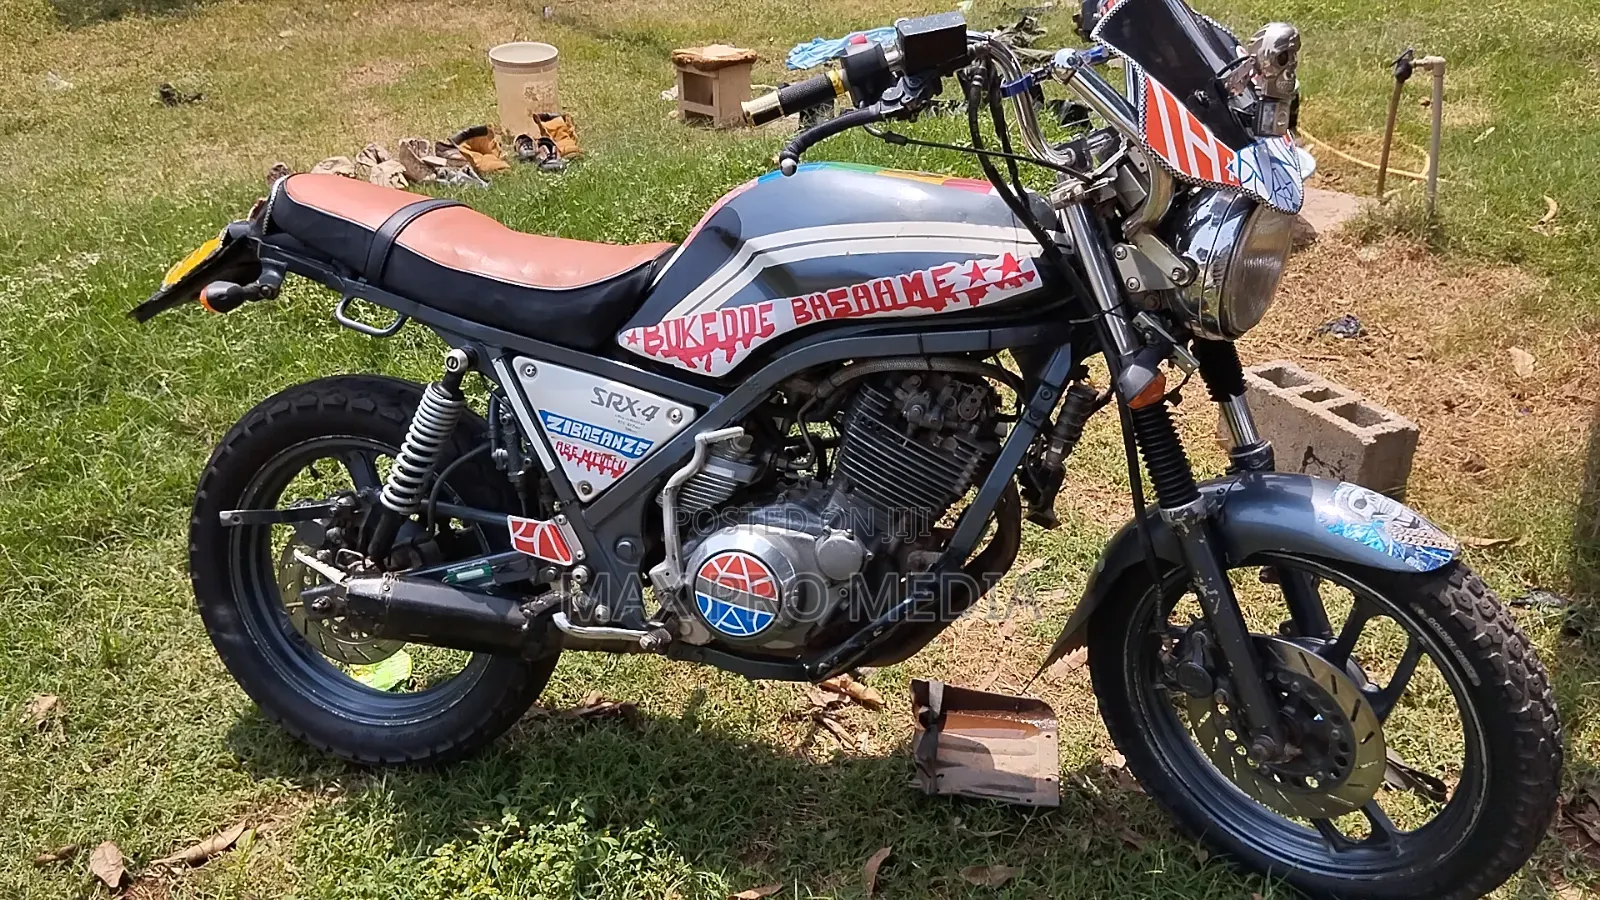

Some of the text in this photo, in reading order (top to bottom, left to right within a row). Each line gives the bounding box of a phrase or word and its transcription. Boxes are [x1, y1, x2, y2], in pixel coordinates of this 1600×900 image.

[643, 303, 776, 368] BUKEDDE
[591, 386, 660, 422] SRX-4
[546, 415, 651, 456] ZIBASANZE
[556, 441, 578, 460] ABE
[1428, 617, 1456, 647] GOLDEN
